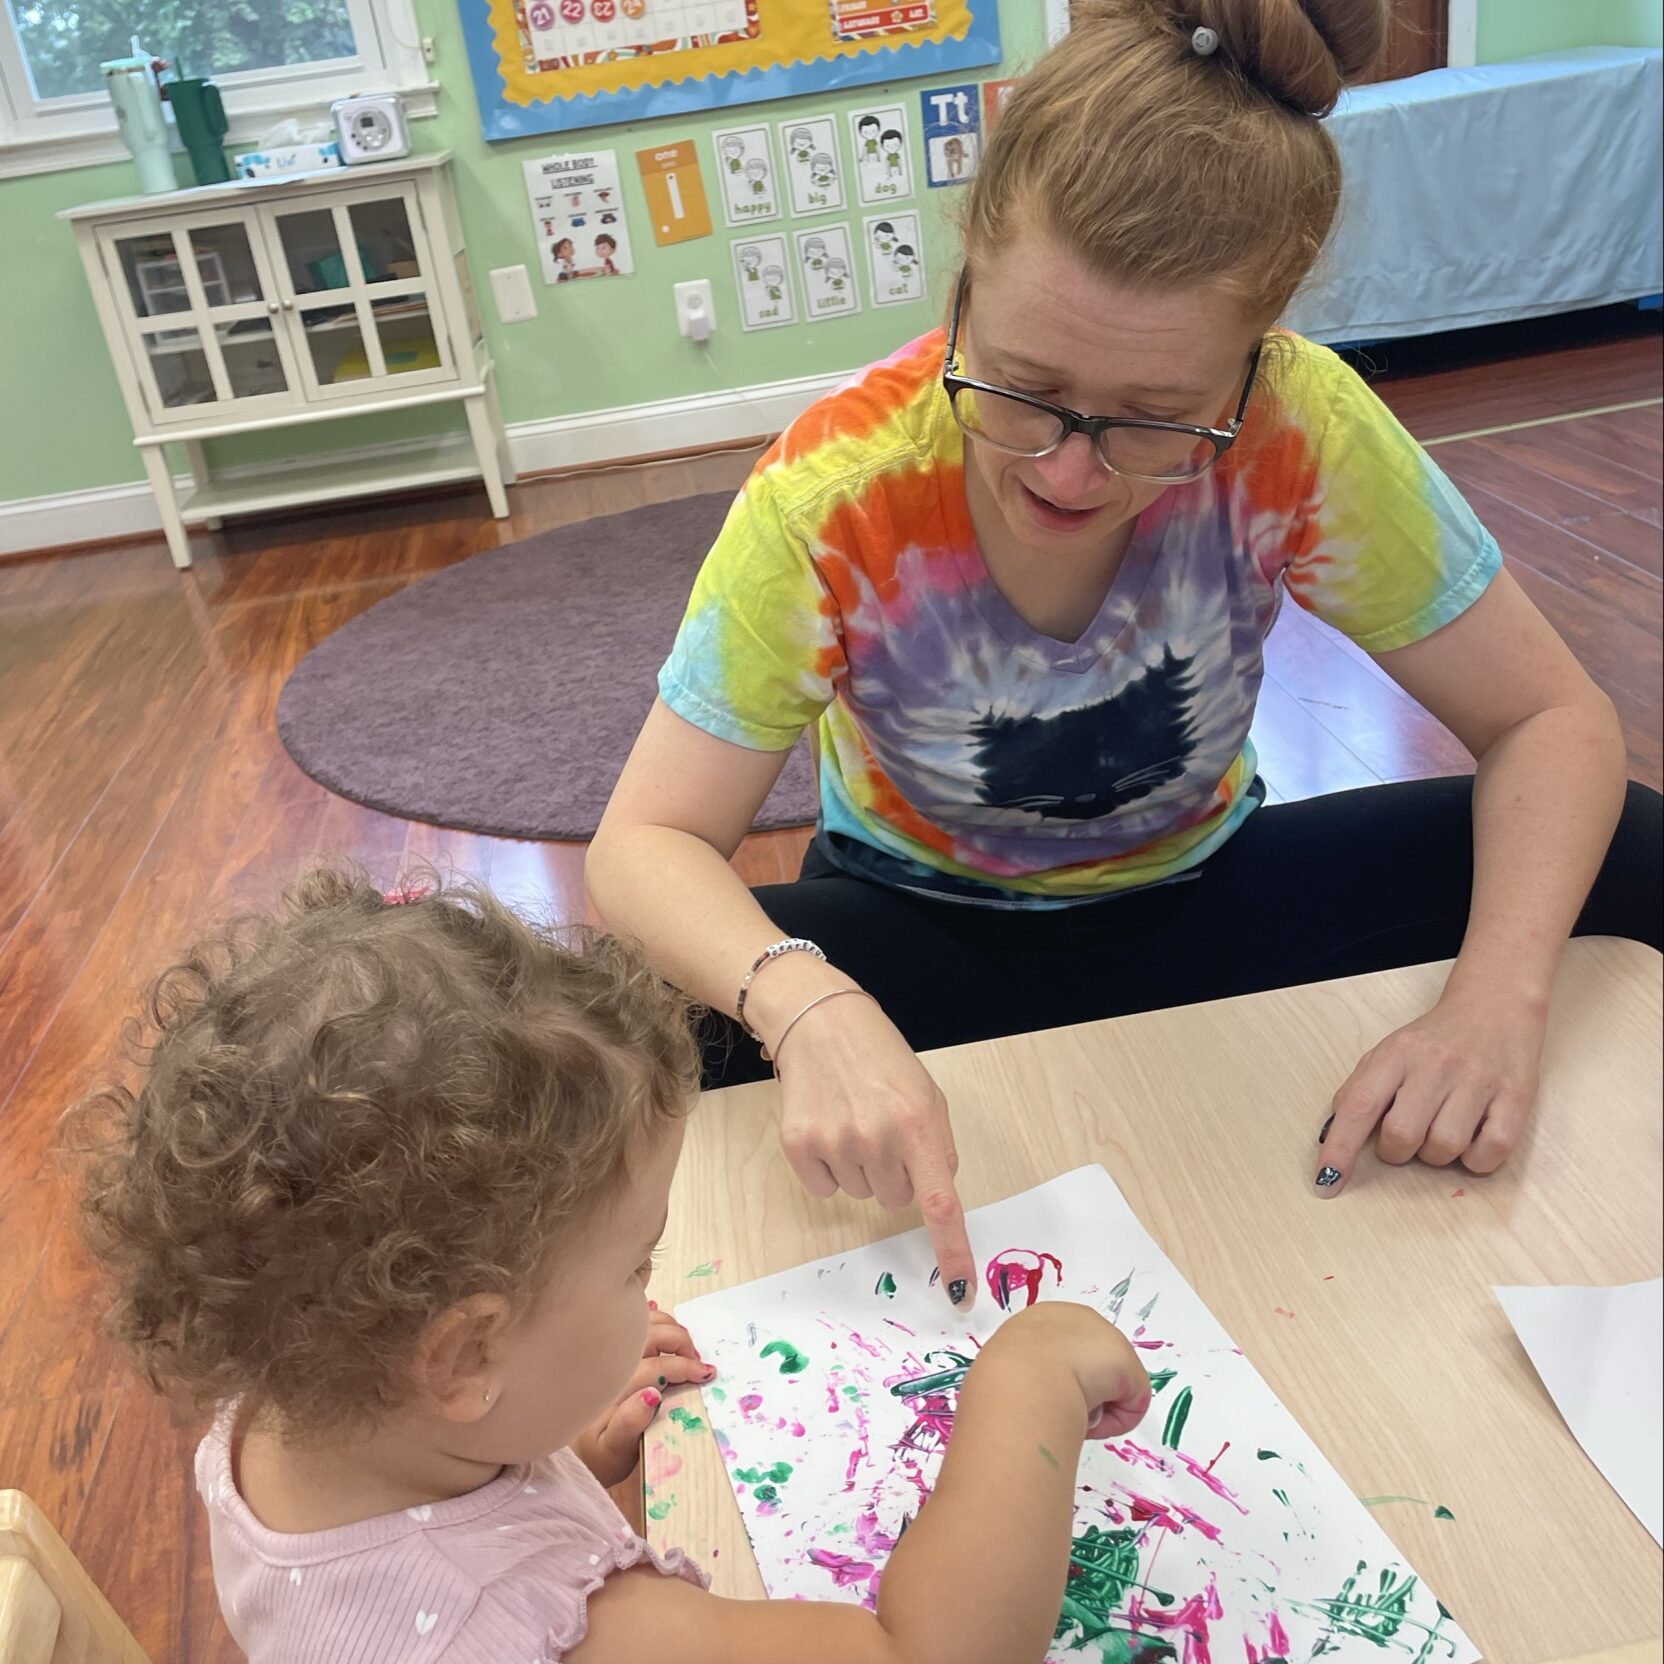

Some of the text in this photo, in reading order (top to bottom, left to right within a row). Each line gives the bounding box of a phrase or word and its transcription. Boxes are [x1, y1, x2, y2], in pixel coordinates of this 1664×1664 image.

[532, 6, 551, 25] 21
[563, 1, 581, 17] 22
[930, 92, 970, 126] Tt
[550, 174, 594, 189] LISTENING
[875, 183, 897, 194] dog
[808, 192, 827, 205] big
[734, 201, 771, 214] happy
[889, 284, 909, 296] cat
[817, 296, 846, 309] little
[759, 306, 779, 318] sad
